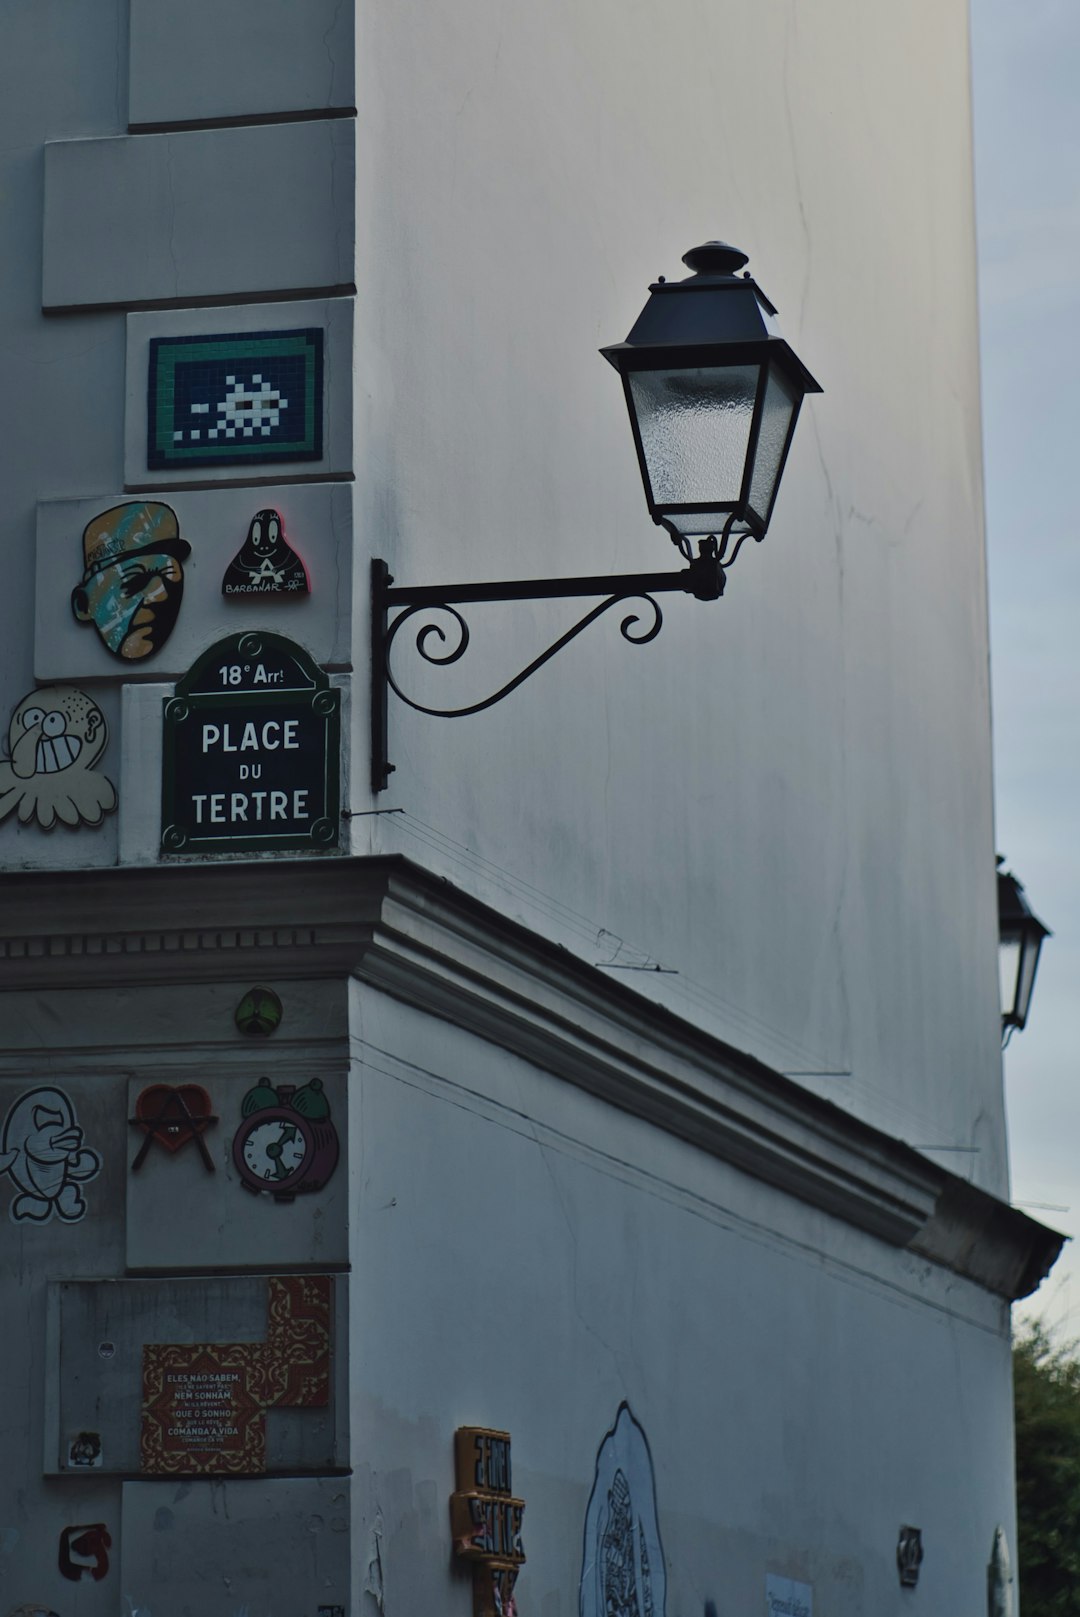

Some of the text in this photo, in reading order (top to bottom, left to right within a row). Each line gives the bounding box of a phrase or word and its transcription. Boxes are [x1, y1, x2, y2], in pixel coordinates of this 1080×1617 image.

[202, 720, 300, 753] PLACE
[239, 764, 262, 780] DU
[192, 789, 310, 824] TERTRE
[167, 1374, 188, 1382] ELES
[174, 1392, 192, 1400] NEM
[176, 1410, 231, 1418] QUE O SONHO
[168, 1428, 209, 1436] COMANDA
[219, 1427, 239, 1435] VIDA
